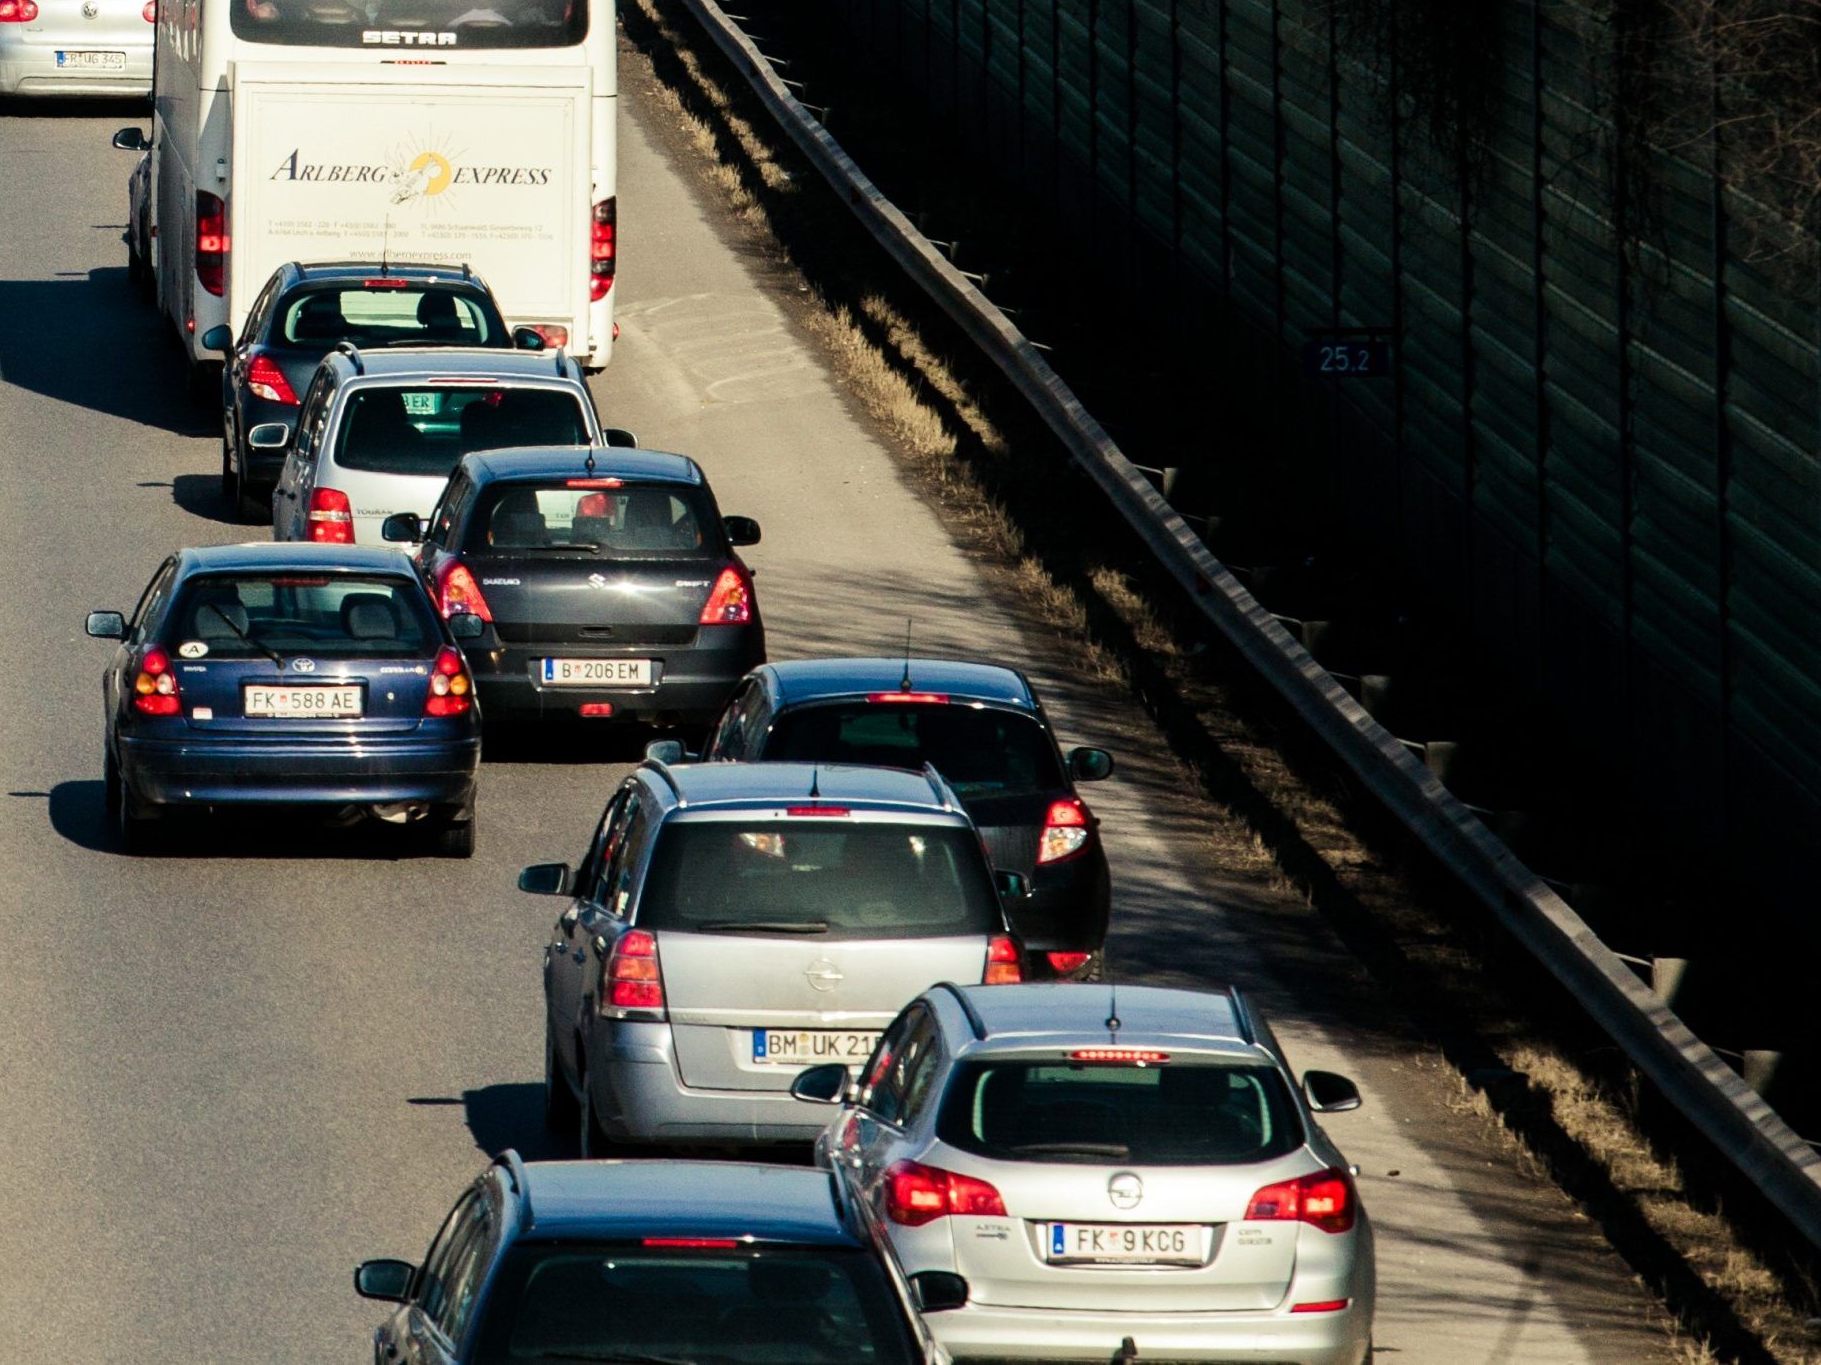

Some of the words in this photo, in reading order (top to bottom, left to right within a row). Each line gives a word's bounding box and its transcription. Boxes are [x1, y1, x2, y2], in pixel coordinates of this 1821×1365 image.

[362, 30, 458, 46] SETRA
[269, 147, 389, 183] ARLBERG
[452, 166, 552, 185] EXPRESS
[1319, 345, 1371, 373] 25.2
[675, 579, 711, 587] SWIFT
[562, 662, 573, 679] B
[584, 663, 614, 680] 206
[618, 664, 640, 681] EM
[253, 692, 275, 708] FK
[292, 693, 326, 709] 588
[331, 692, 354, 709] AE
[768, 1034, 797, 1055] BM
[812, 1035, 841, 1056] UK
[1077, 1229, 1103, 1248] FK
[1123, 1230, 1136, 1249] 9
[1142, 1231, 1186, 1250] KCG
